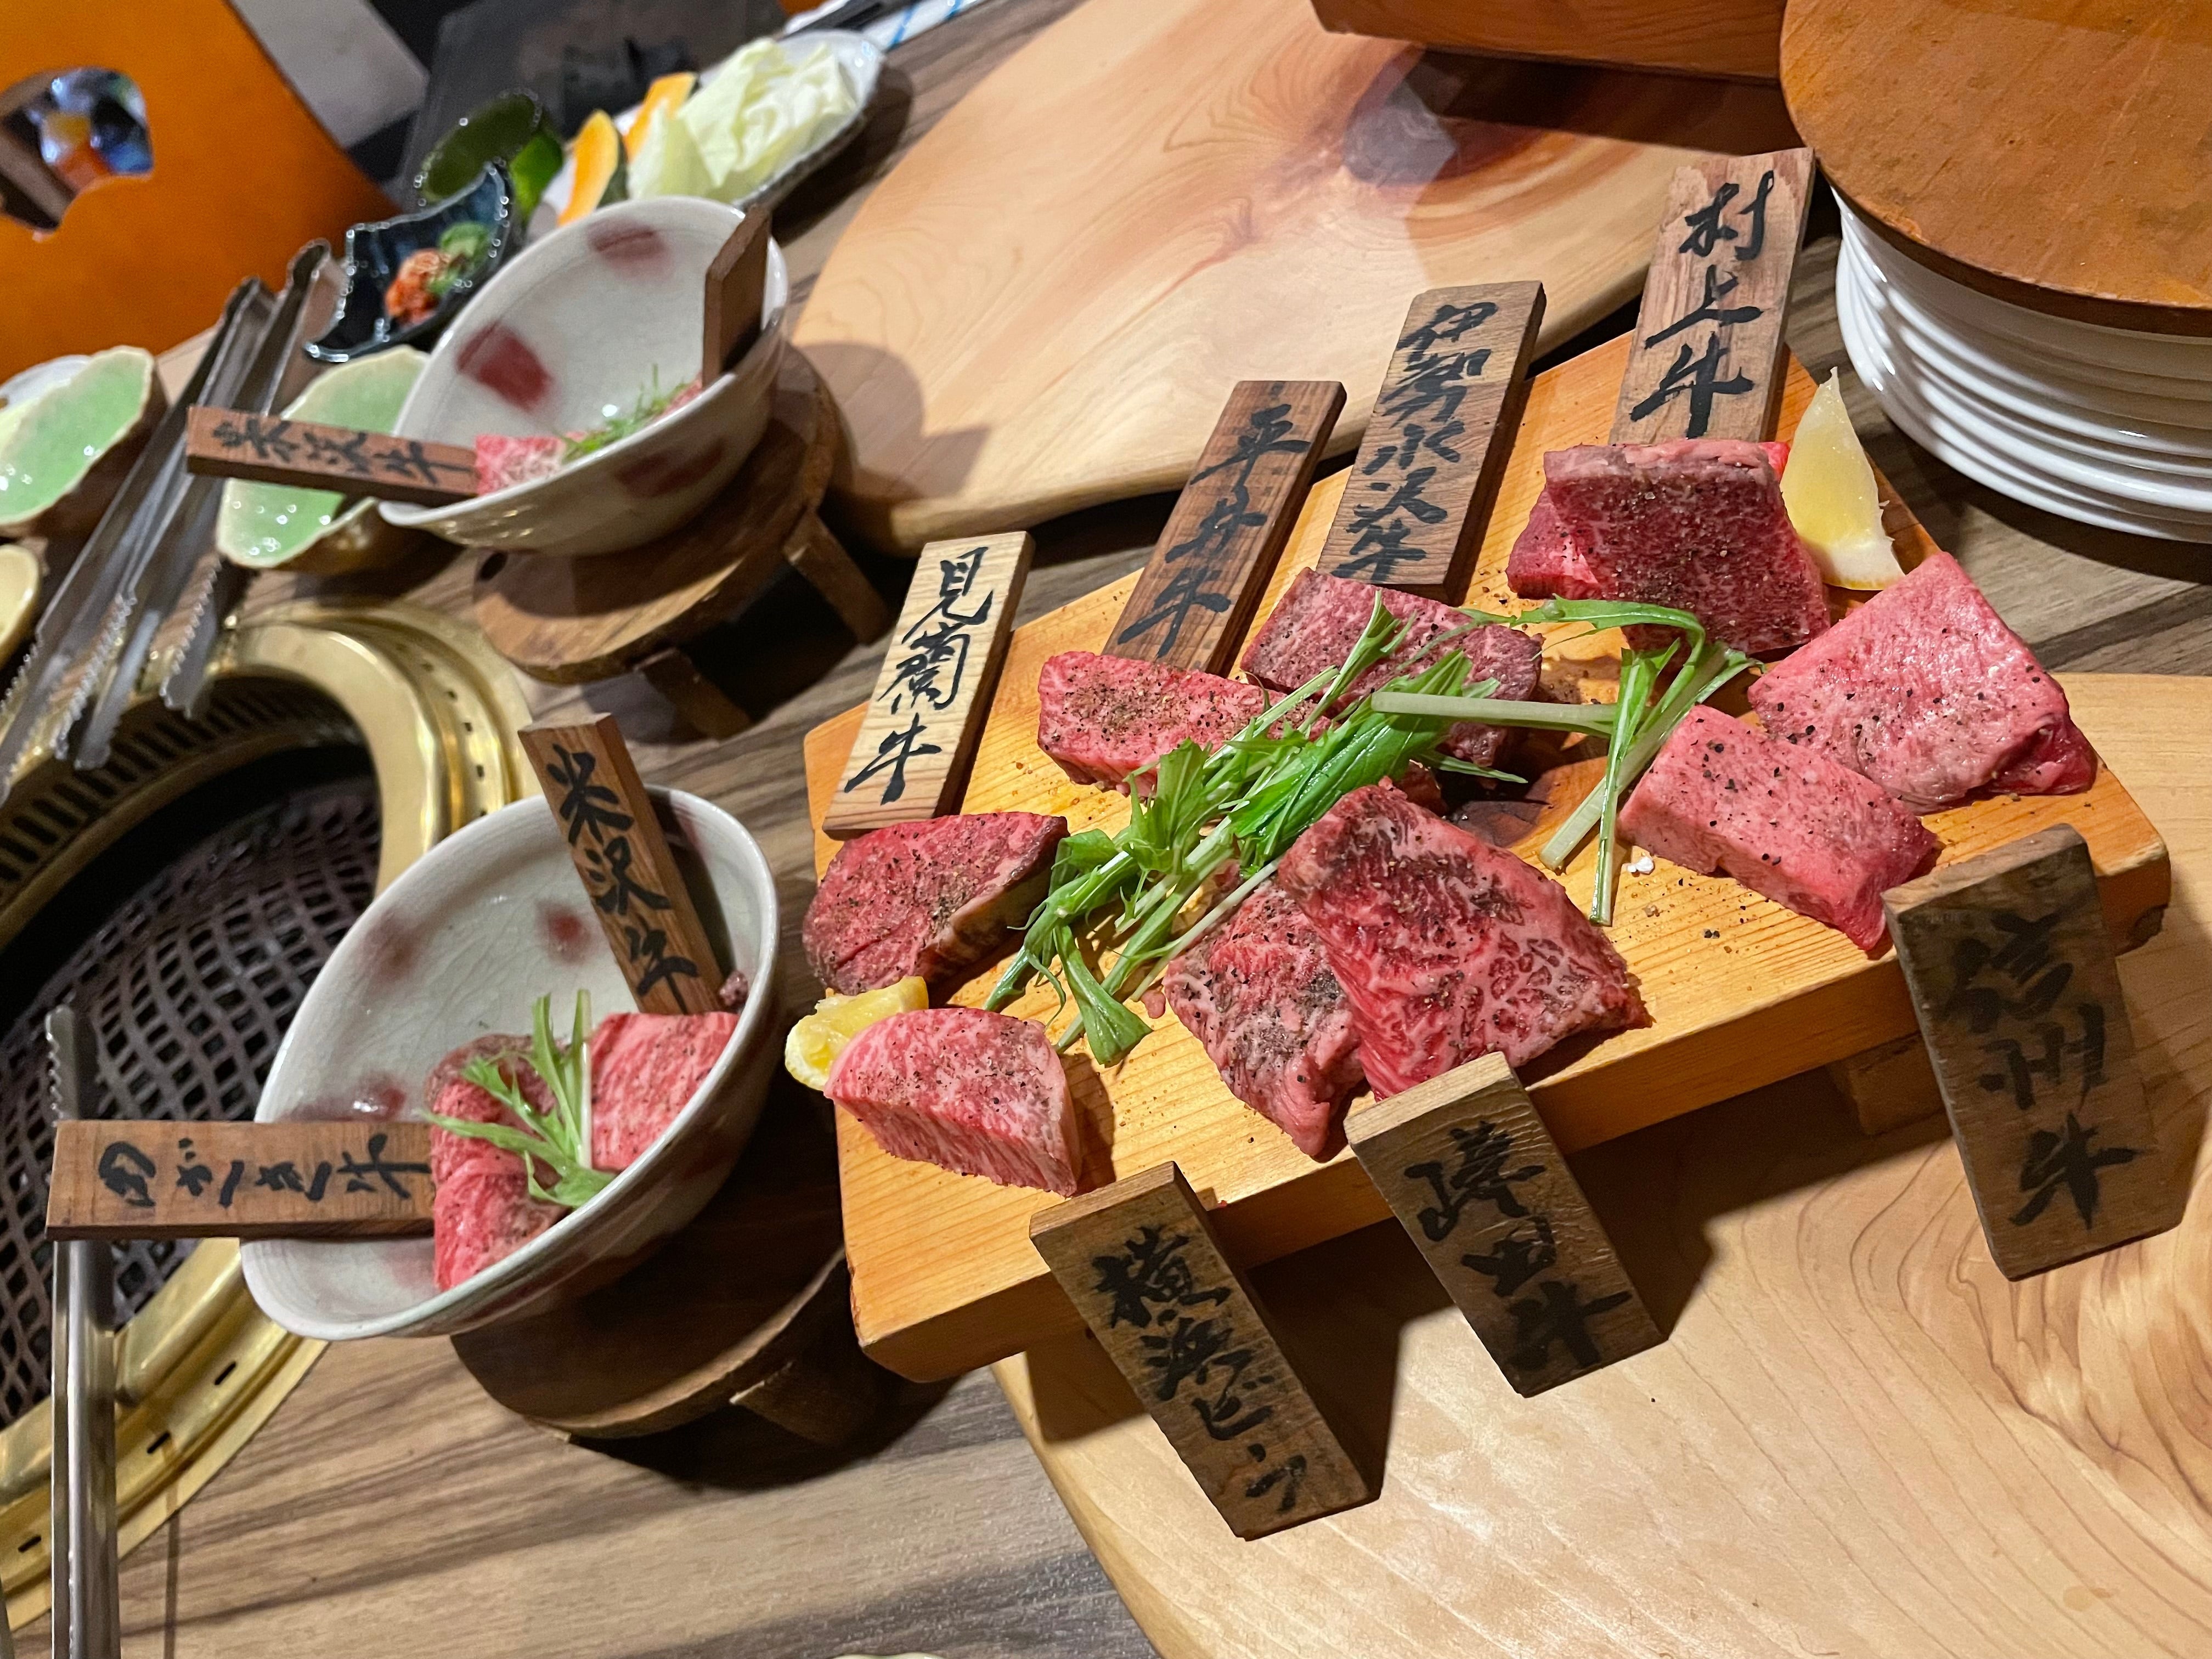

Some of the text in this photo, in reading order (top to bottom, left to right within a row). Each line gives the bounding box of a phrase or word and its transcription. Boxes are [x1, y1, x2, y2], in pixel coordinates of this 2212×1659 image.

[1629, 170, 1763, 439] 村上牛
[545, 743, 699, 1015] 米沢牛
[98, 1133, 433, 1208] のざき牛
